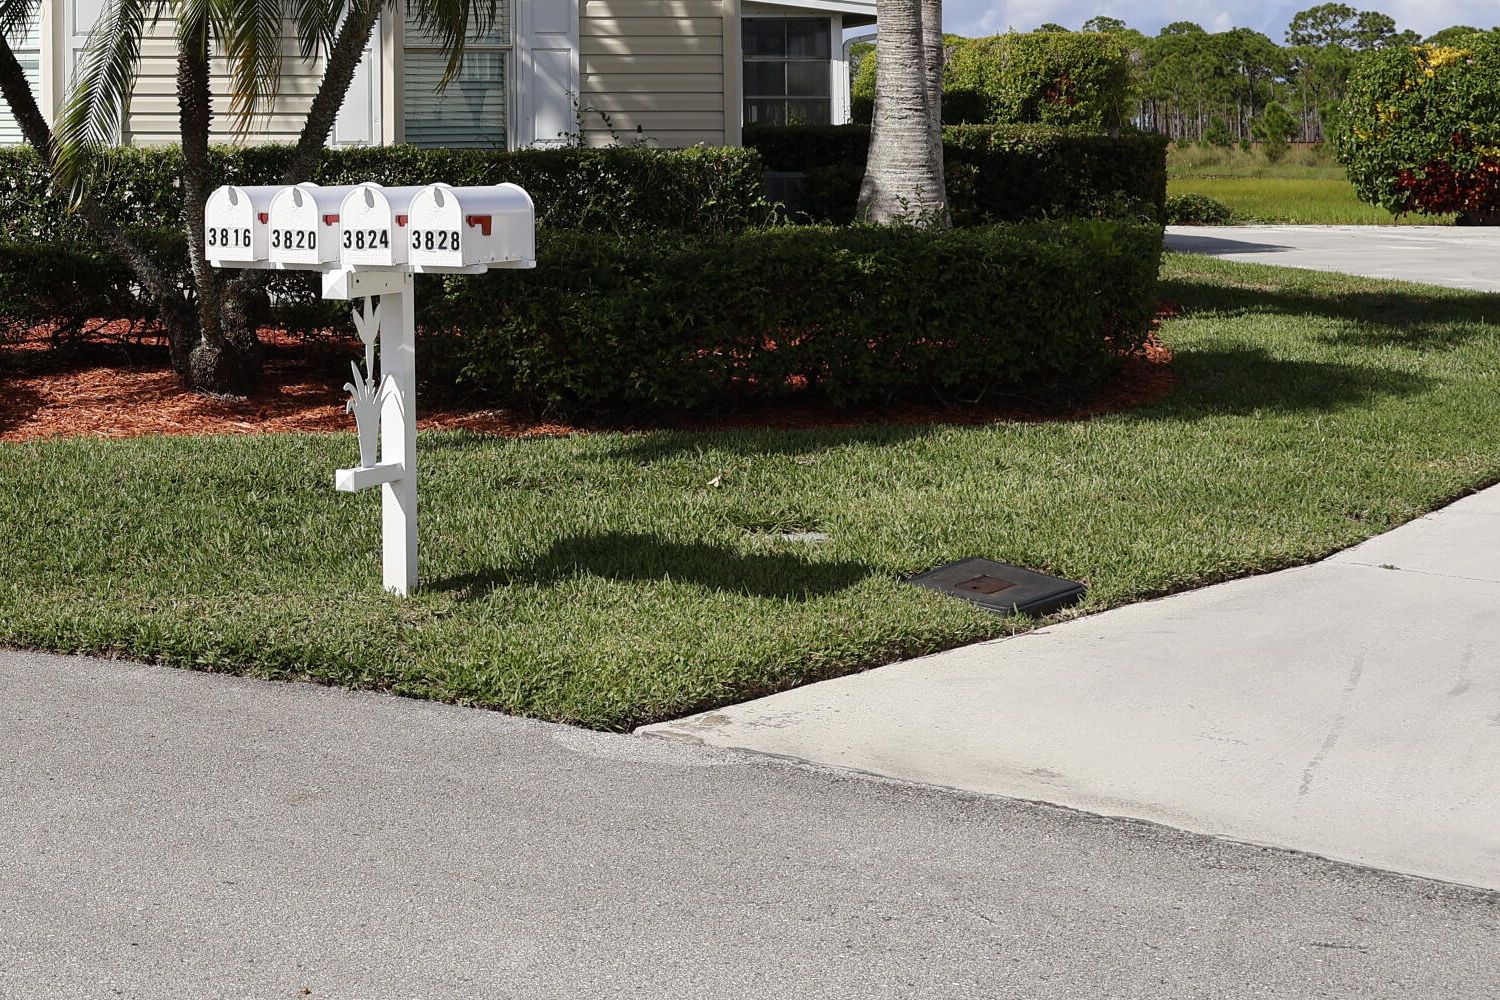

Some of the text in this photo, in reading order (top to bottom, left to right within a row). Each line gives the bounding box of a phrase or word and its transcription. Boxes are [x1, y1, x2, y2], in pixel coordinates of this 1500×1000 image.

[208, 227, 251, 247] 3816
[272, 229, 316, 249] 3820
[343, 229, 389, 249] 3824
[412, 230, 460, 251] 3828
